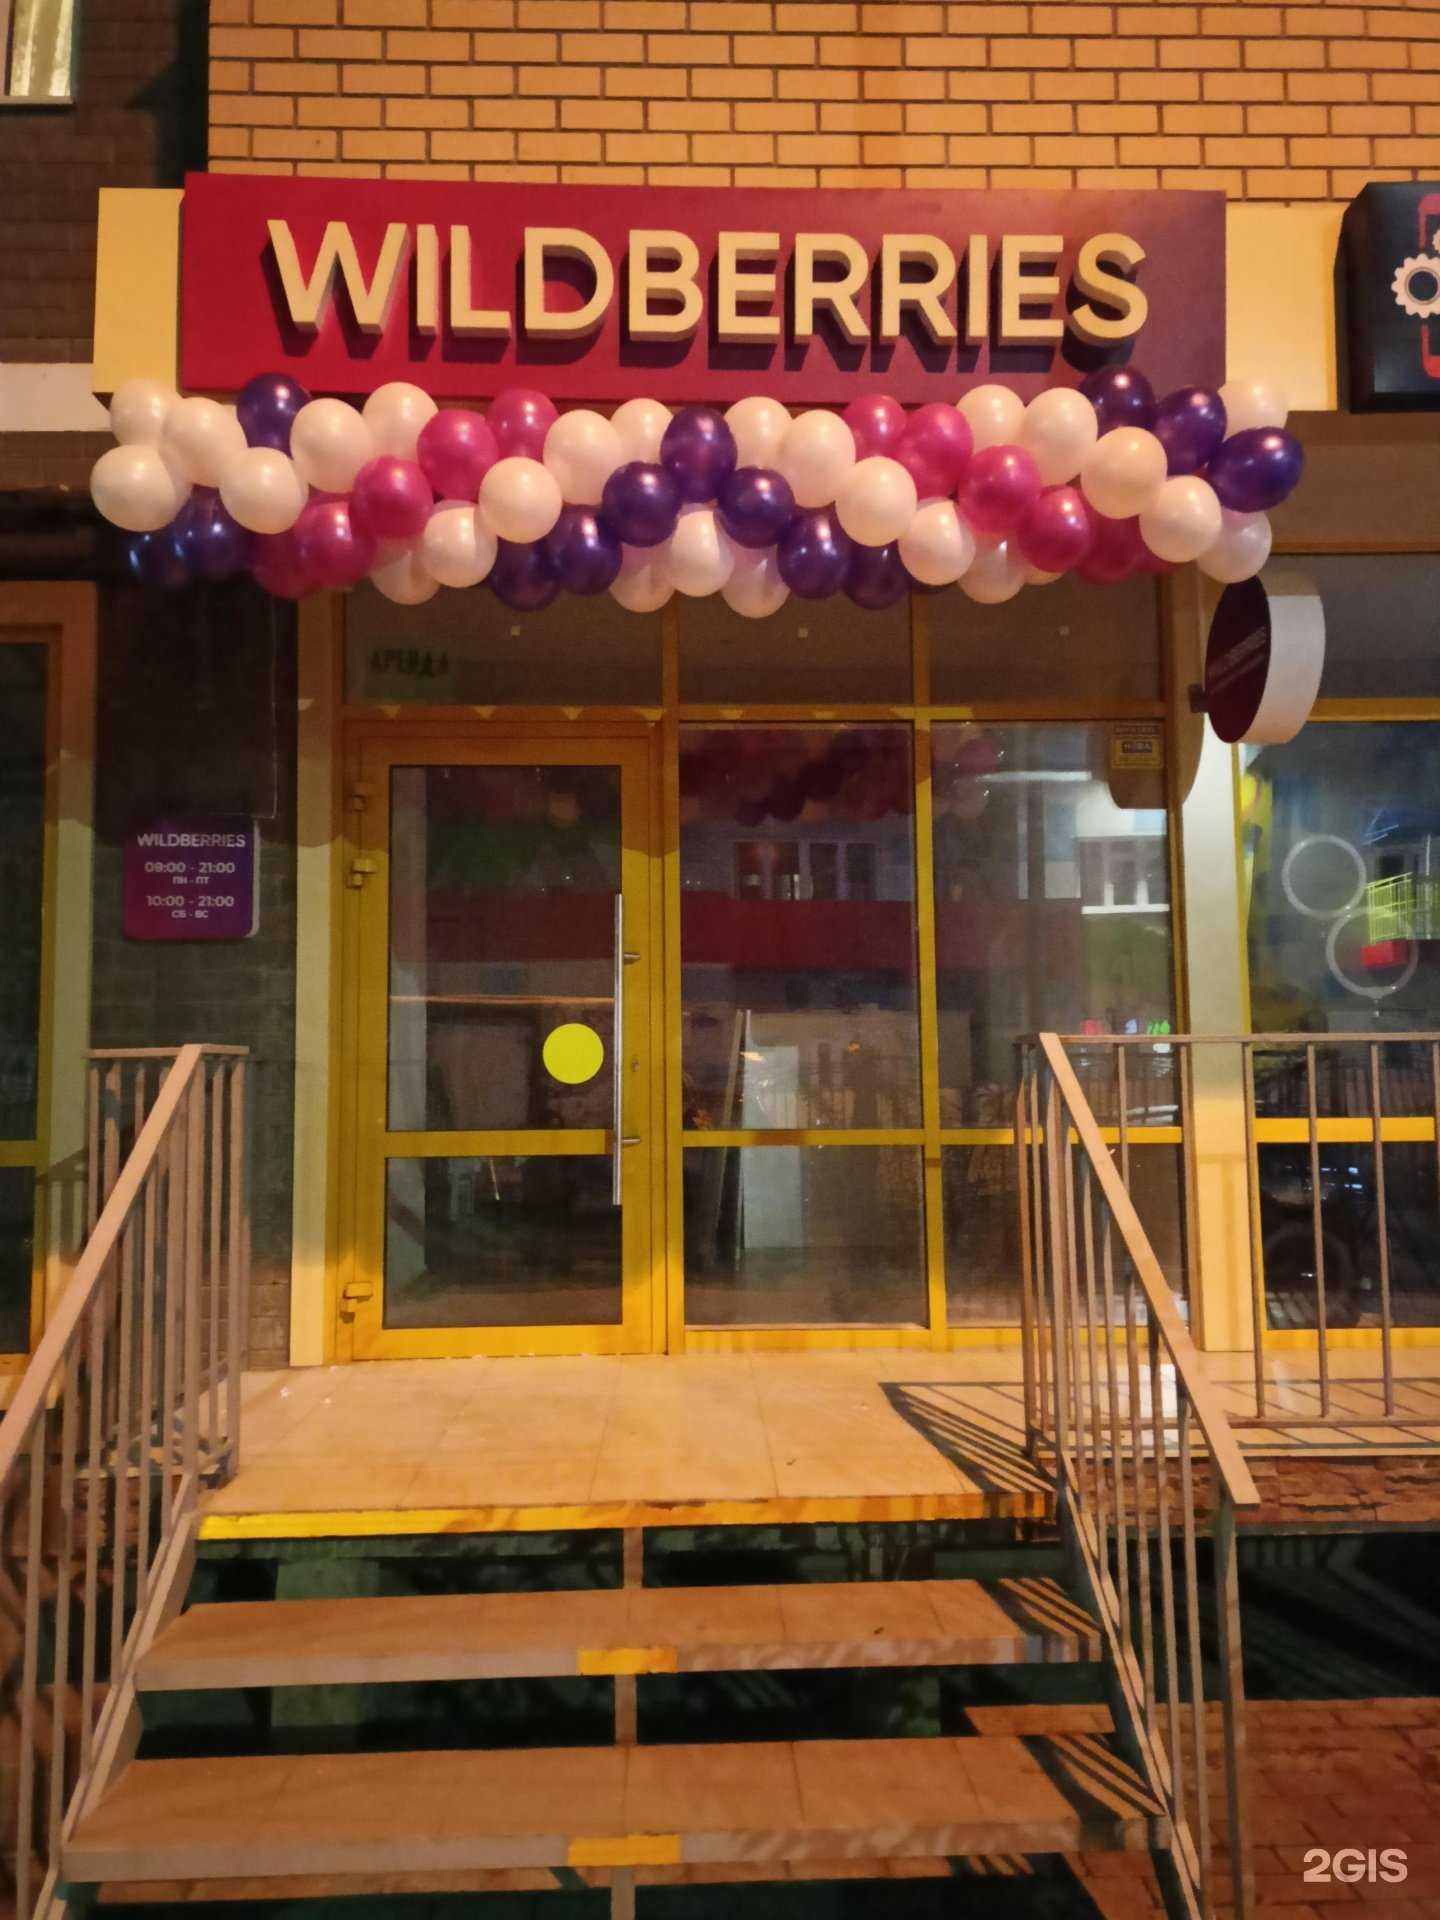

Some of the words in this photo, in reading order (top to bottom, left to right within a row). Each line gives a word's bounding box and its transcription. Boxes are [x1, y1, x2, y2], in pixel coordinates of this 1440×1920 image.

[266, 218, 1150, 347] WILDBERRIES
[137, 833, 246, 848] WILDBERRIES
[145, 862, 186, 873] 09:00
[199, 862, 235, 873] 21:00
[146, 895, 185, 907] 10:00
[197, 895, 235, 907] 21:00
